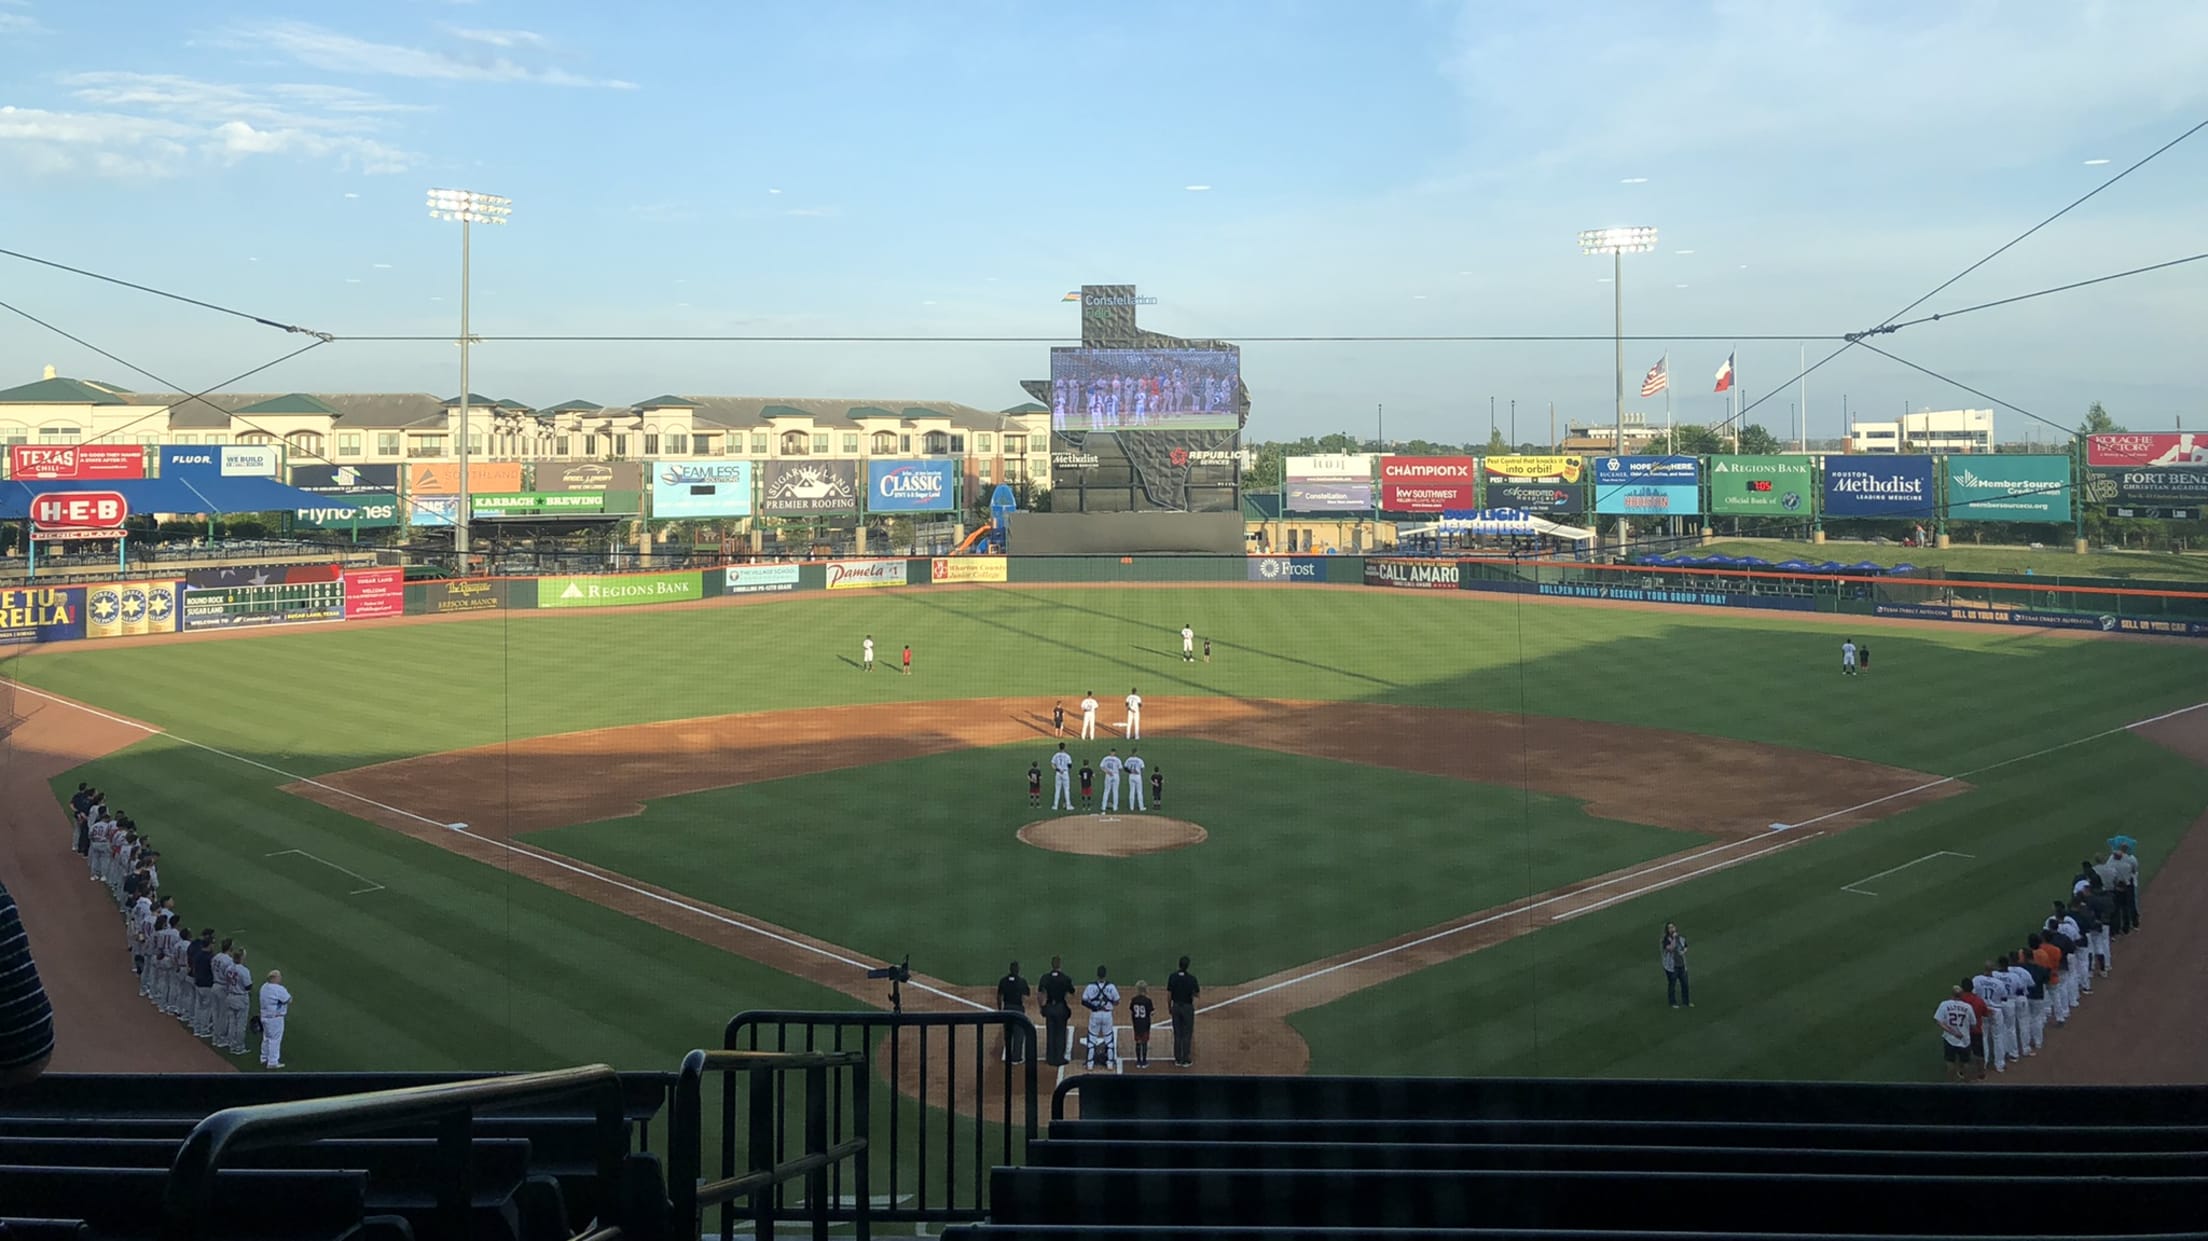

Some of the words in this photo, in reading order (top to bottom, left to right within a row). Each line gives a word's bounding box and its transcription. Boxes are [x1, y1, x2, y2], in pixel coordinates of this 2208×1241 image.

[1085, 294, 1157, 306] Constellation
[1086, 308, 1112, 319] Field
[20, 451, 74, 466] TEXAS
[172, 455, 211, 464] FLUOR
[1053, 453, 1099, 464] Methodist
[1189, 451, 1241, 459] REPUBLIC
[1506, 464, 1524, 473] into
[1526, 464, 1553, 474] orbit!
[1731, 463, 1776, 473] REGIONS
[1778, 463, 1807, 473] BANK
[445, 471, 519, 481] SOTHLAND
[768, 467, 800, 496] SUGAR
[823, 469, 851, 494] LAND
[2123, 473, 2166, 484] FORT
[880, 474, 942, 497] CLASSIC
[1832, 475, 1922, 493] Methodist
[1978, 480, 2061, 488] MemberSource
[1305, 492, 1347, 500] Constellation
[1412, 489, 1457, 498] SOUTHWEST
[475, 498, 534, 507] KARBACH
[546, 496, 603, 505] BREWING
[766, 500, 809, 509] PREMIER
[811, 499, 855, 509] ROOFING
[1480, 509, 1530, 521] LIGHT
[1281, 561, 1315, 576] Frost
[1380, 564, 1408, 580] CALL
[1409, 566, 1459, 583] AMARO
[827, 564, 884, 588] Pamela
[588, 583, 654, 598] REGIONS
[656, 582, 690, 593] BANK
[1539, 584, 1573, 595] BULLPEN
[1575, 586, 1598, 596] PATIO
[21, 588, 56, 607] TU
[1609, 588, 1643, 599] RESERVE
[1647, 590, 1668, 600] YOUR
[1670, 591, 1697, 602] GROUP
[1700, 593, 1727, 604] TODAY
[187, 607, 207, 616] SUGAR
[207, 606, 224, 614] LAND
[1951, 610, 1968, 619] SELL
[1977, 611, 1994, 620] YOUR
[2121, 619, 2139, 630] SELL
[1948, 1012, 1967, 1027] 27
